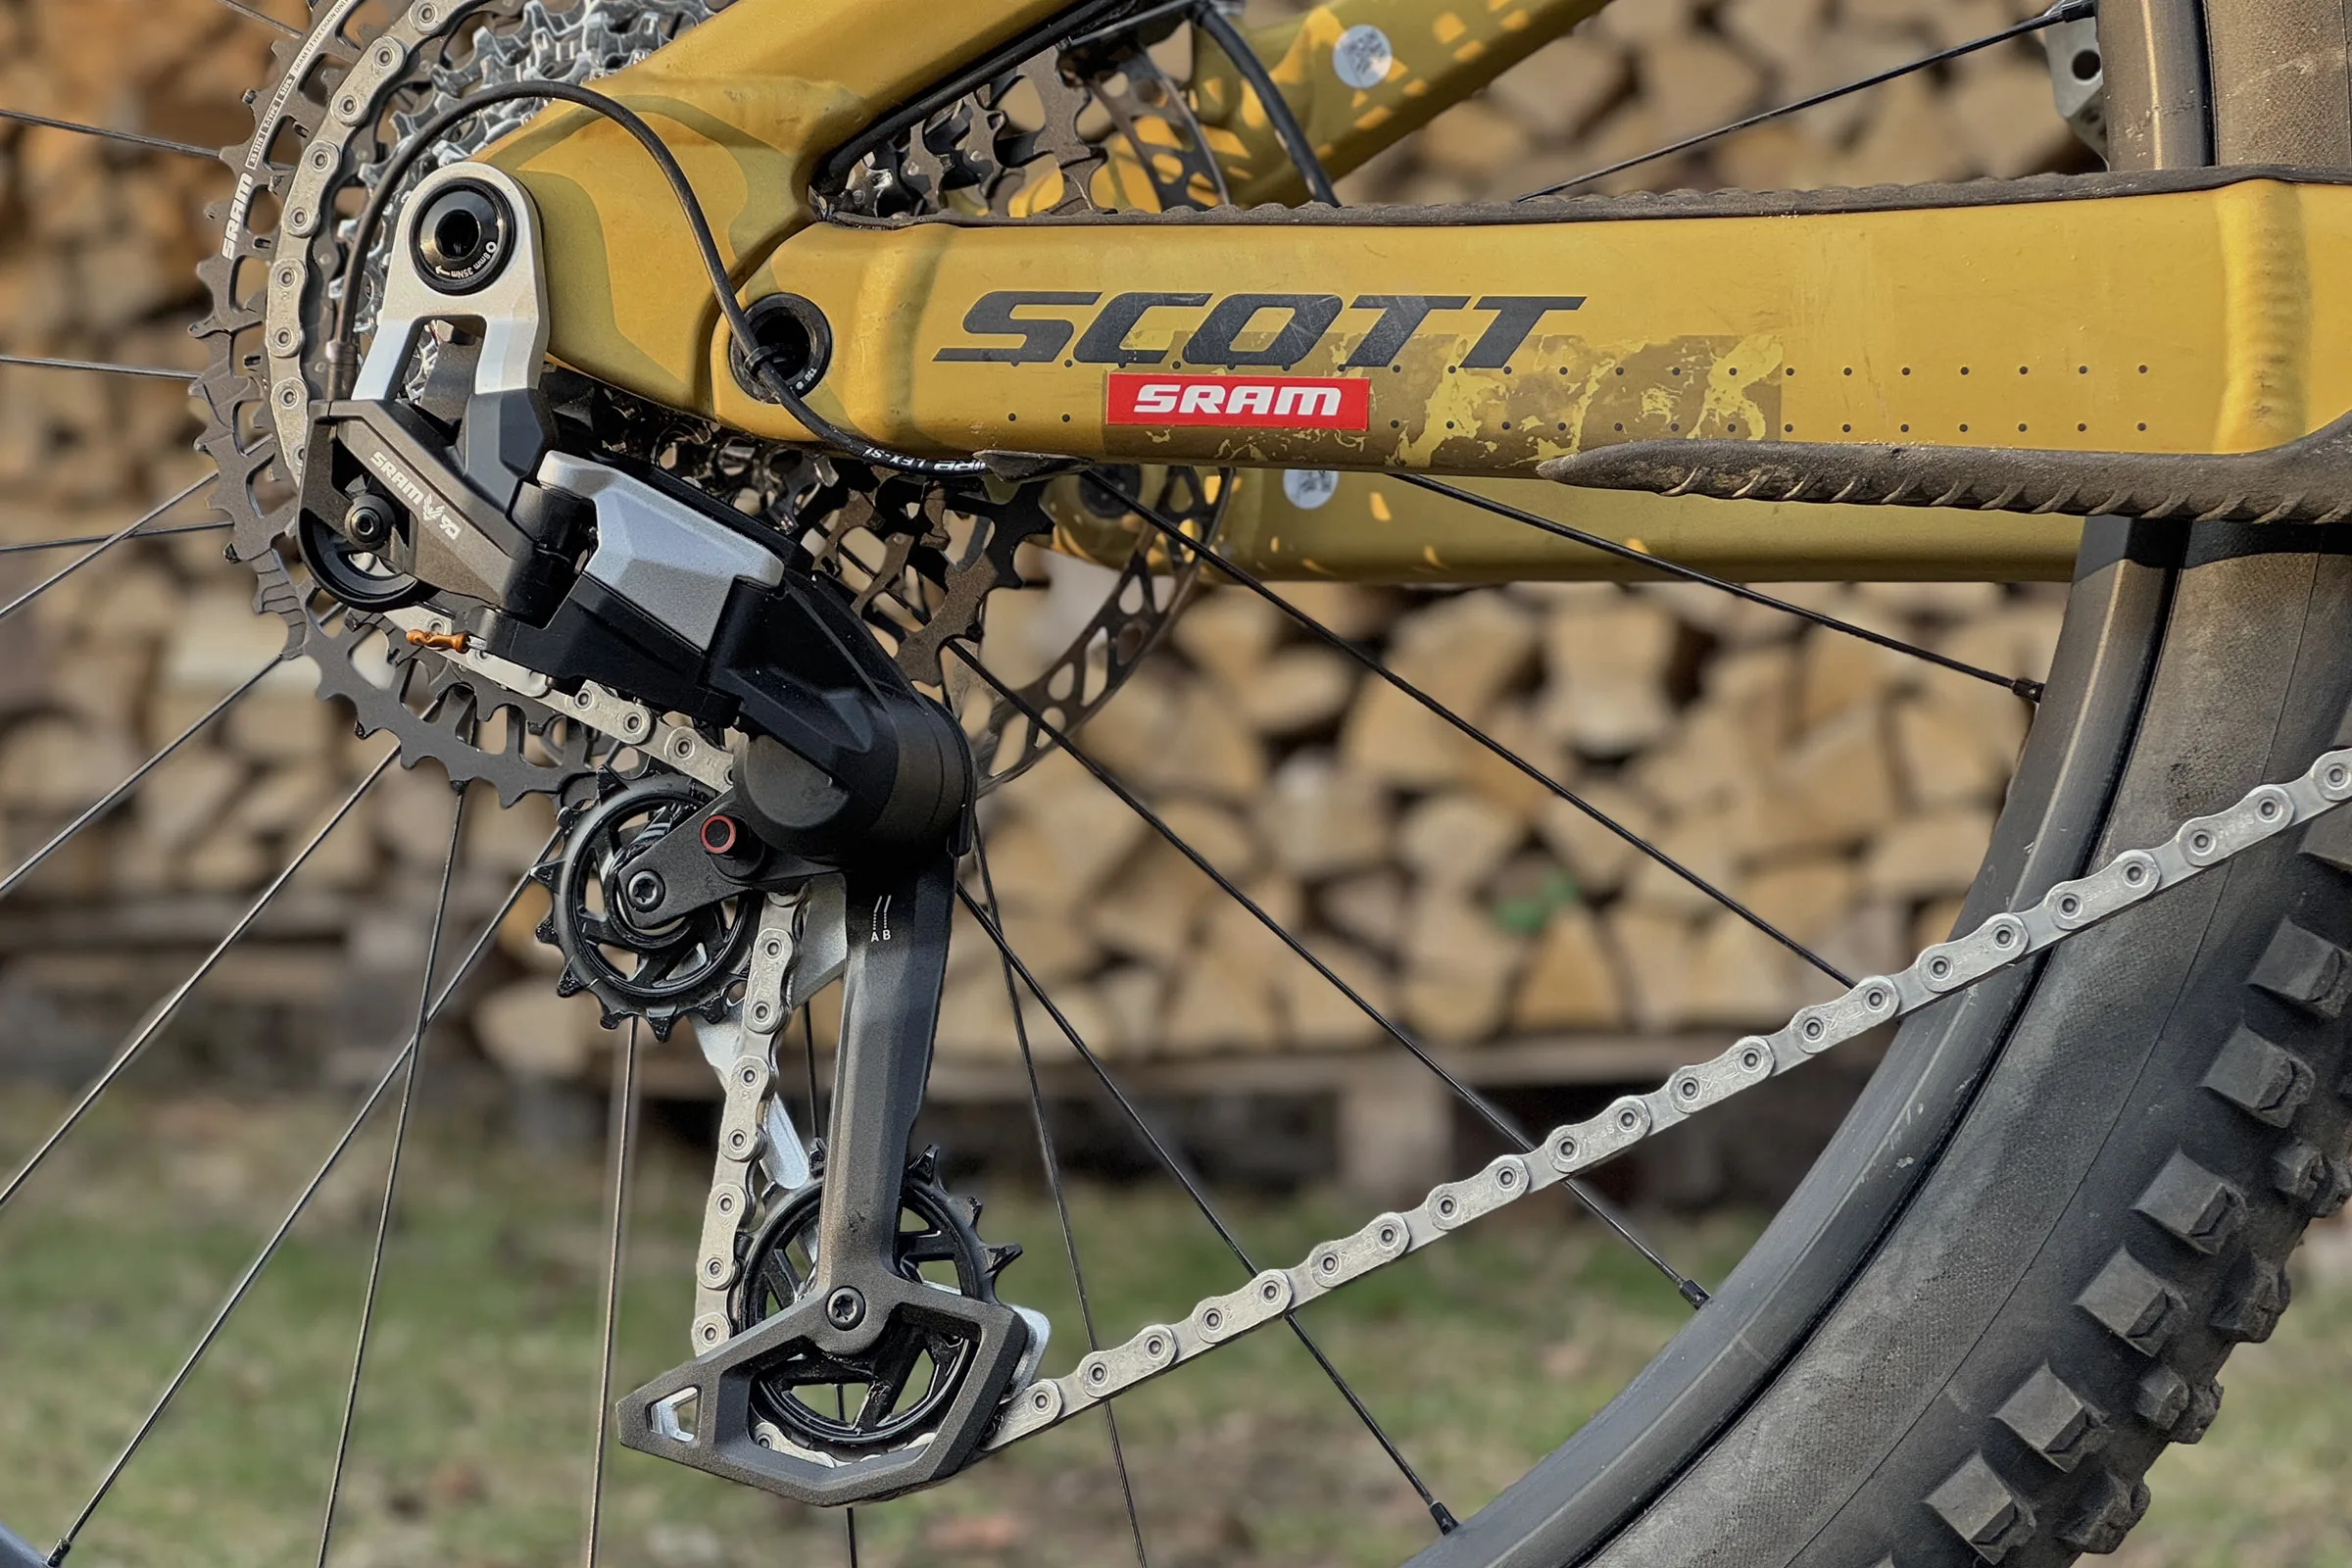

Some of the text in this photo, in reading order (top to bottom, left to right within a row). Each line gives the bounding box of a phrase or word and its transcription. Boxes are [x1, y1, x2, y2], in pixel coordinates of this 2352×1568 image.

[221, 172, 254, 260] SRAM
[451, 267, 474, 279] 35Nm
[932, 290, 1588, 368] SCOTT
[1134, 384, 1342, 417] SRAM
[862, 446, 926, 467] LEX-SL
[369, 451, 423, 506] SRAM
[870, 929, 892, 942] A B
